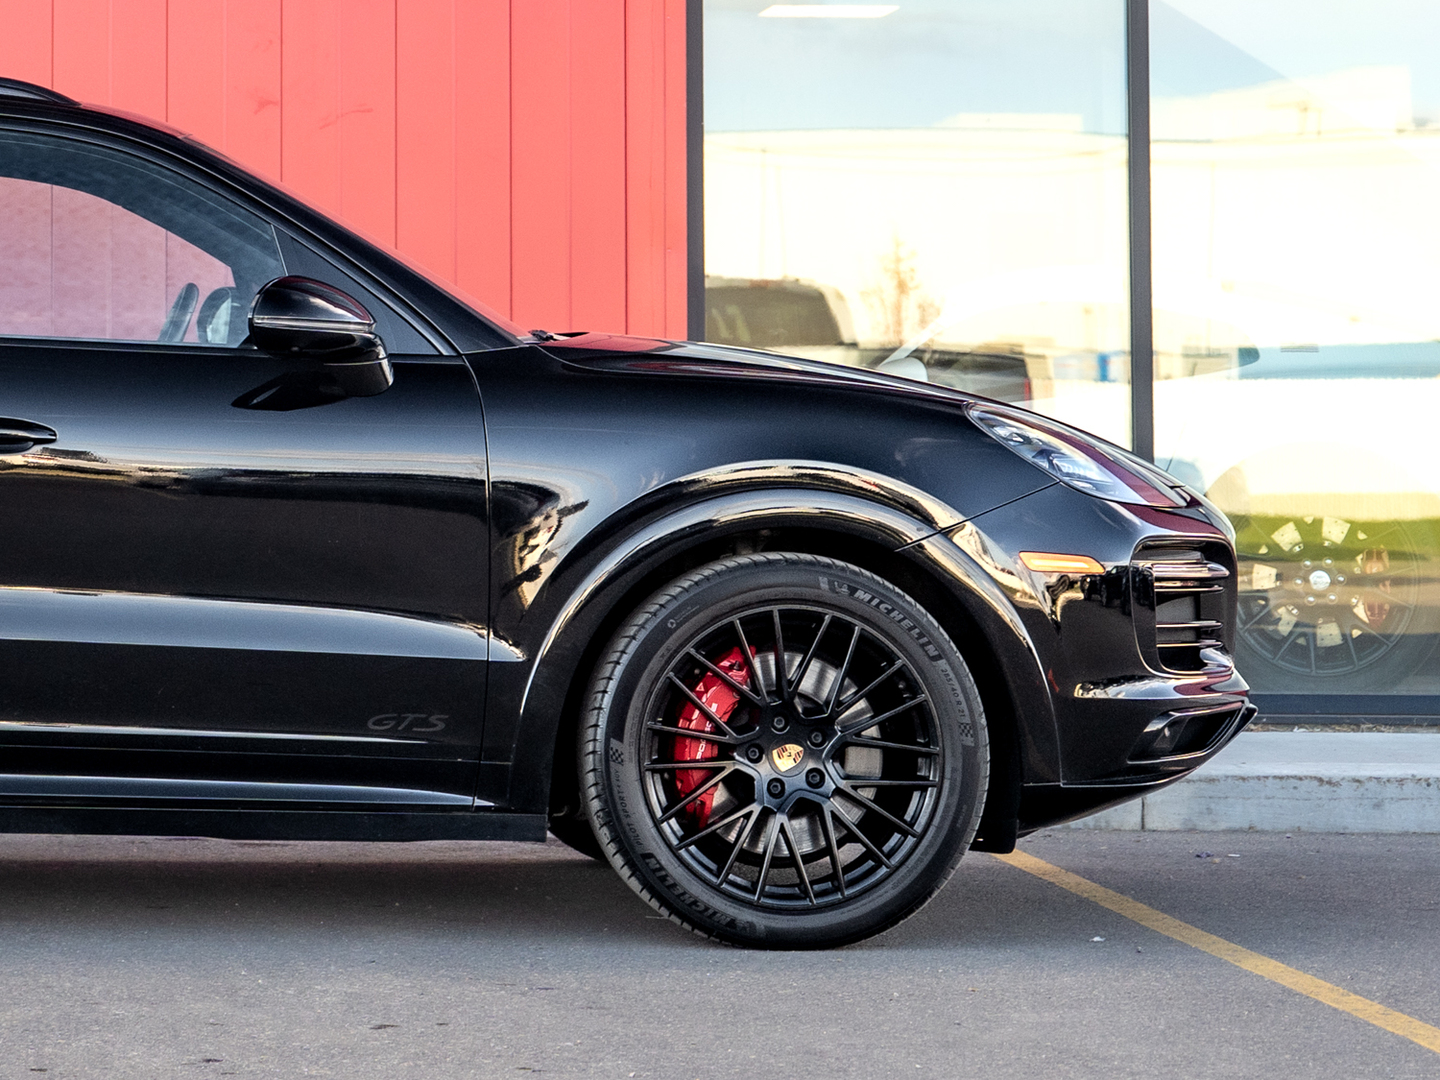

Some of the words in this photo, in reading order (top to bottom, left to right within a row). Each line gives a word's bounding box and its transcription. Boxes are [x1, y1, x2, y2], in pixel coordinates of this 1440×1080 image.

[854, 589, 939, 657] MICHELIN
[367, 713, 449, 731] GTS
[618, 790, 631, 818] SPORT
[627, 822, 644, 846] PILOT
[645, 857, 732, 925] MICHELIN
